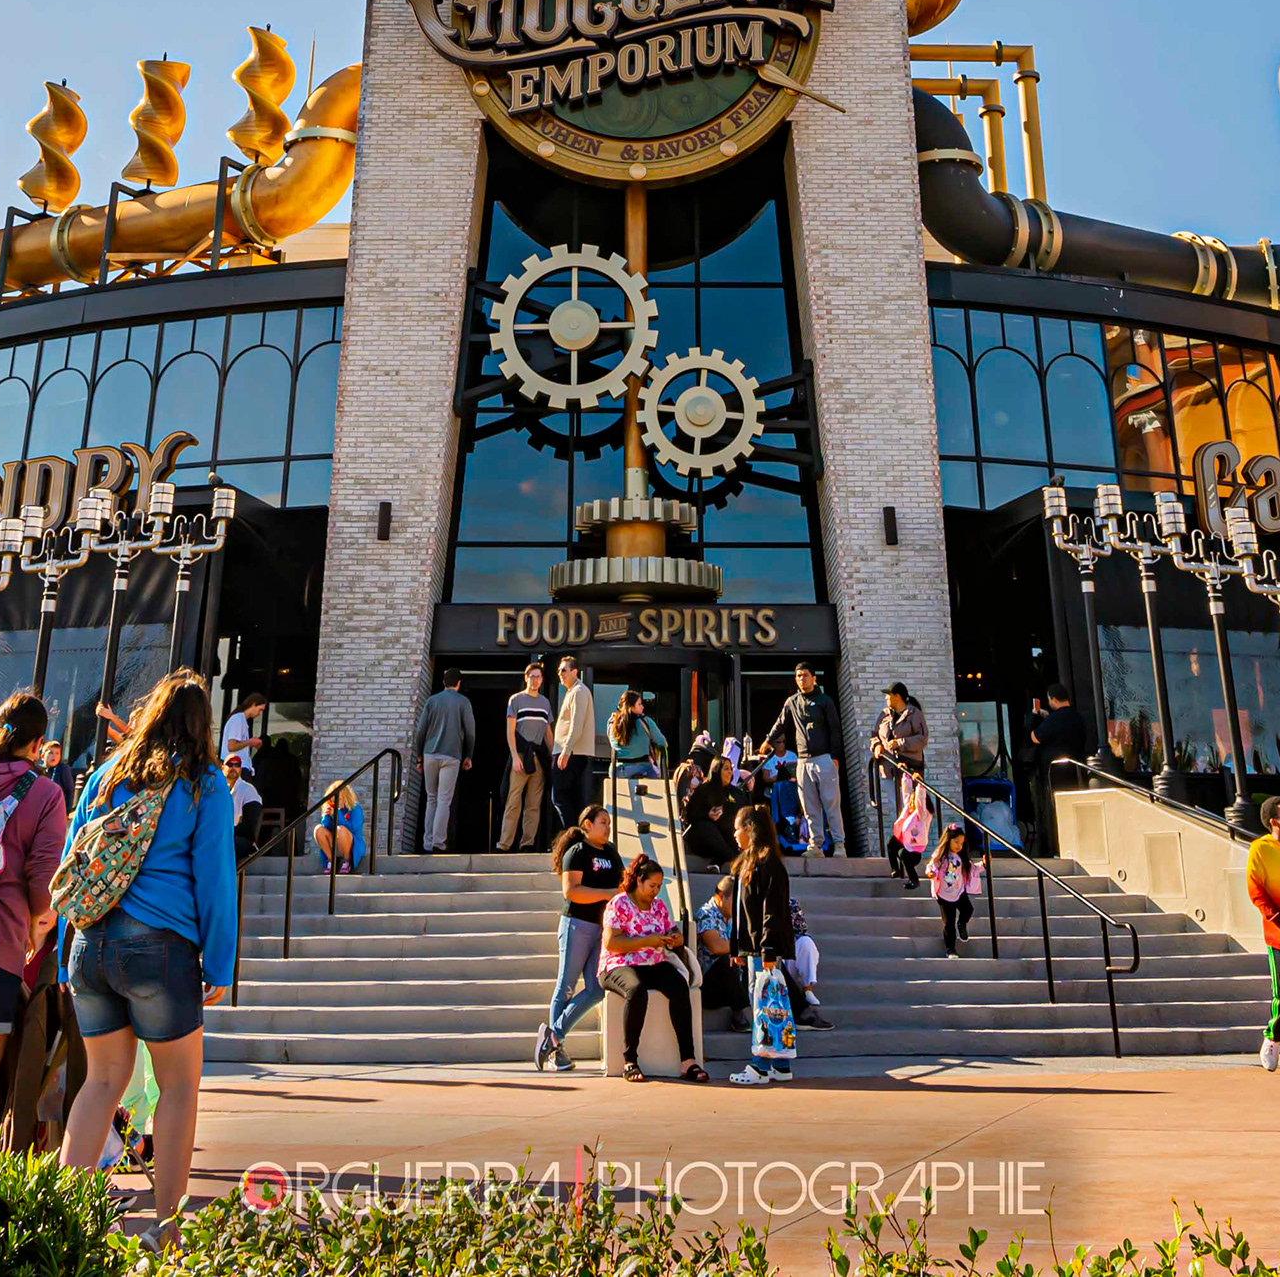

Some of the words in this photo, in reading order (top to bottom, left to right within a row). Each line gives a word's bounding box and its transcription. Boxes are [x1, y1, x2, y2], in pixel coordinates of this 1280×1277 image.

[507, 20, 767, 116] EMPORIUM
[537, 118, 603, 156] CHEN
[620, 143, 639, 161] &
[642, 122, 727, 162] SAVORY
[726, 89, 774, 130] FEA
[496, 607, 591, 646] FOOD
[597, 616, 629, 635] AND
[636, 607, 779, 648] SPIRITS
